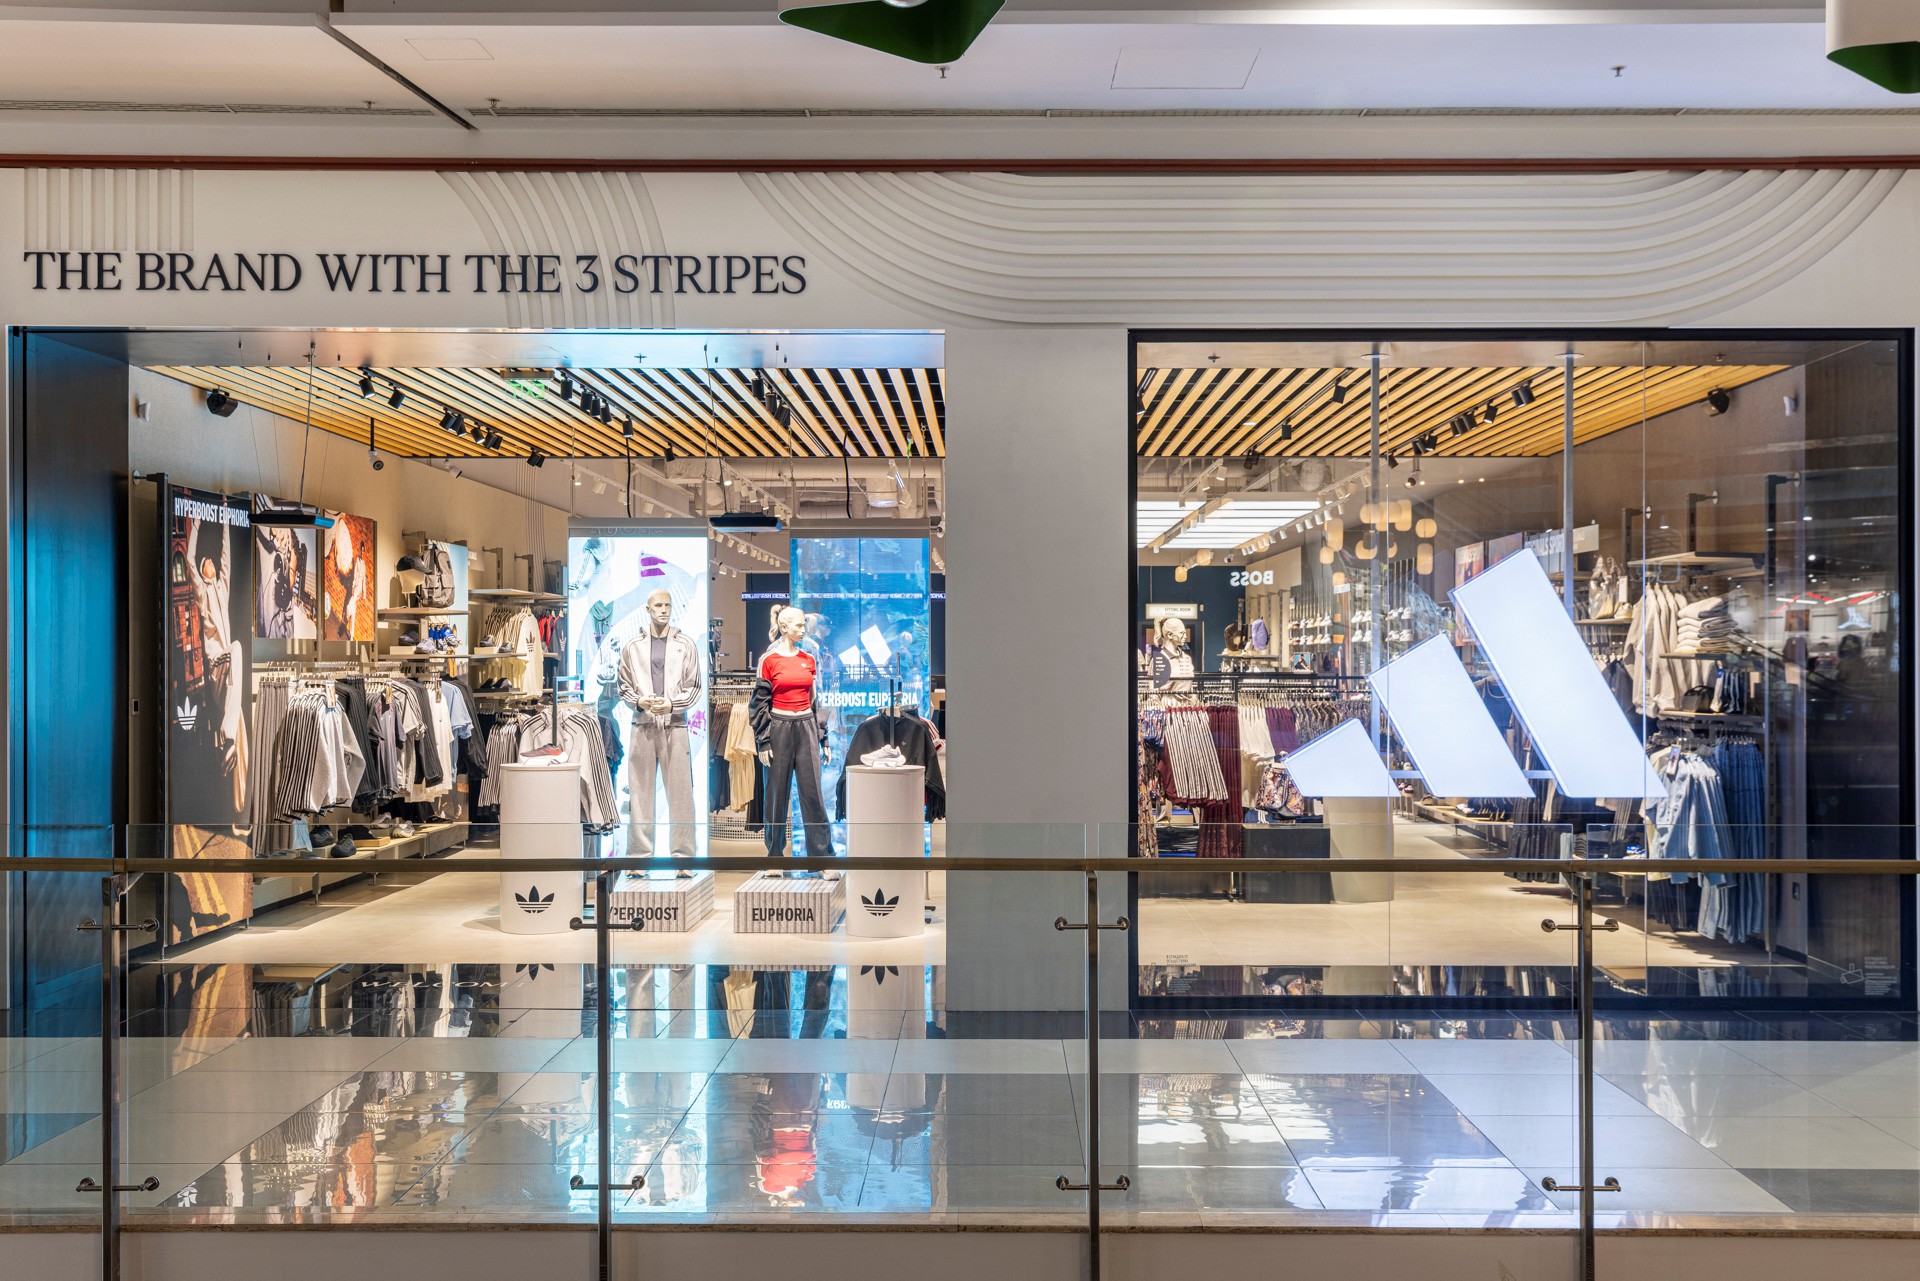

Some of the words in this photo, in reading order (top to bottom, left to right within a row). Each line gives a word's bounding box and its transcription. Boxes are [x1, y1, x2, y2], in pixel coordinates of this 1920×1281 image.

[24, 251, 122, 291] THE
[135, 252, 302, 293] BRAND
[315, 254, 450, 293] WITH
[465, 255, 562, 294] THE
[575, 255, 600, 294] 3
[613, 255, 807, 295] STRIPES
[174, 497, 218, 523] HYPERBOOST
[218, 506, 250, 528] EUPHORIA
[817, 691, 868, 707] PERBOOST
[752, 907, 815, 922] EUPHORIA
